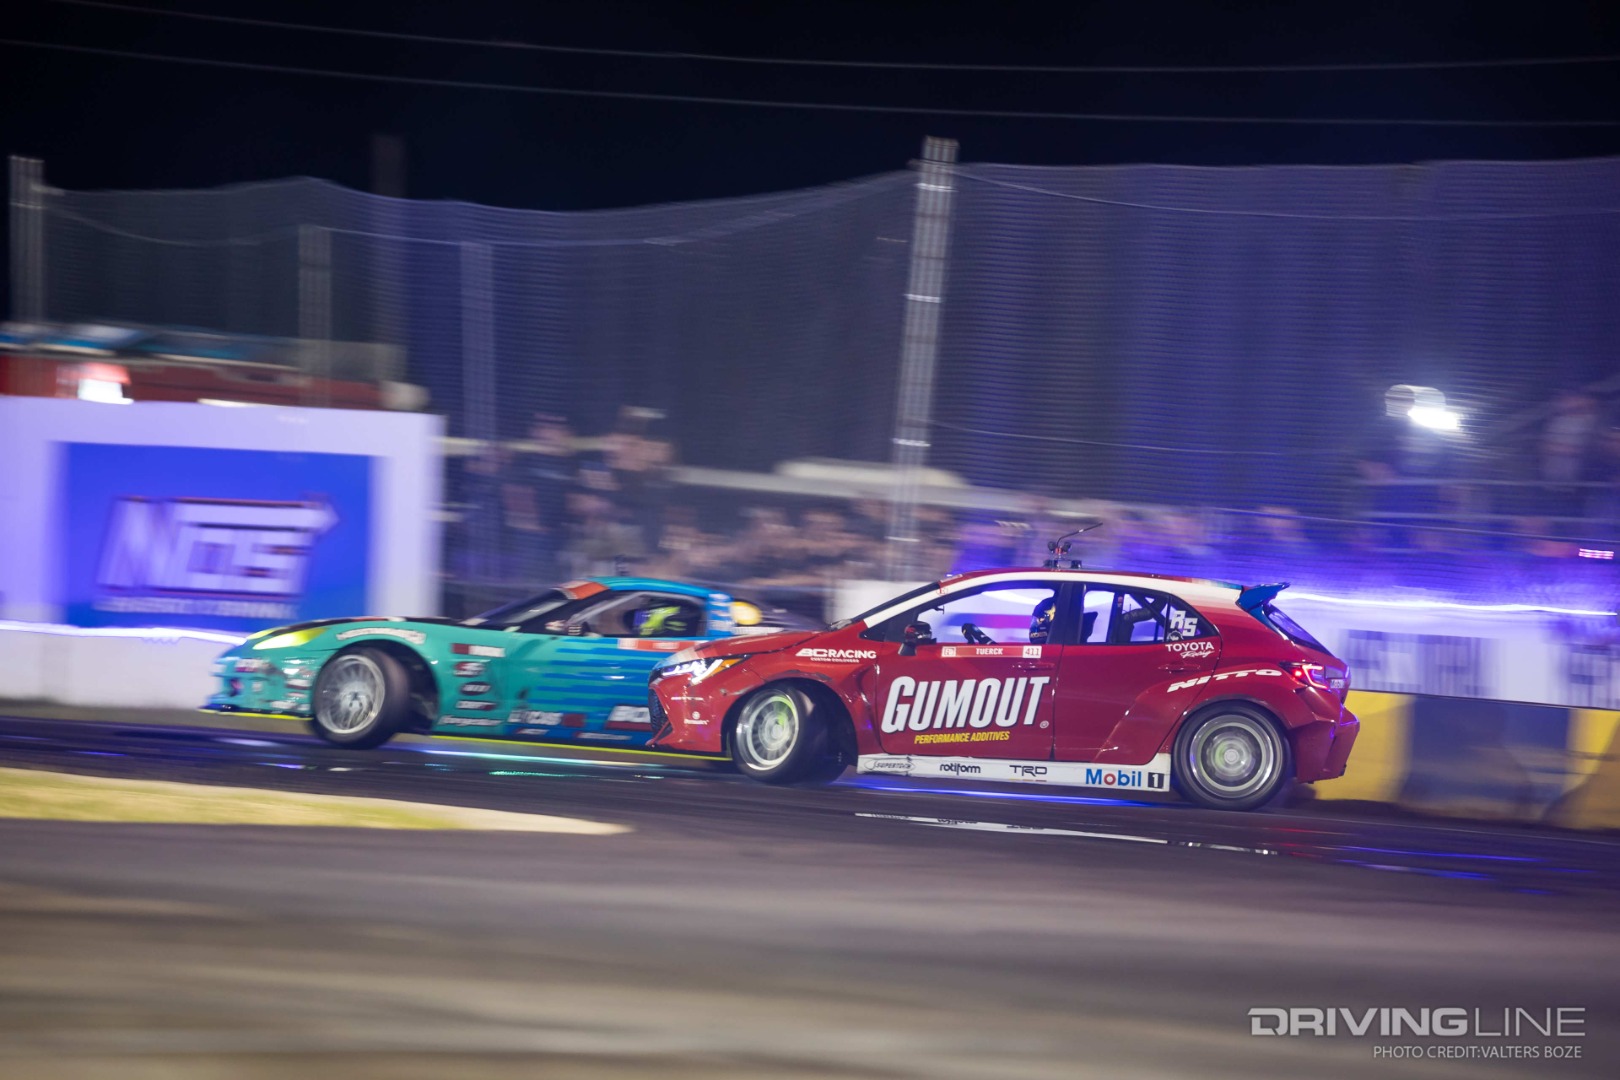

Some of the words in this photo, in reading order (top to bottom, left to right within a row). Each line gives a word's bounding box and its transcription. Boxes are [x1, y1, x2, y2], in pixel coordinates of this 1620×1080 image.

[101, 498, 337, 594] NOS
[1024, 648, 1040, 656] 411
[1165, 642, 1214, 652] TOYOTA
[1167, 669, 1282, 692] NITTO
[881, 676, 1050, 733] GUMOUT
[914, 732, 970, 744] PERFORMANCE
[970, 731, 1010, 741] ADDITIVES
[940, 763, 981, 775] rotiform
[1009, 764, 1047, 777] TRD
[1085, 768, 1141, 787] Mobil
[1151, 773, 1161, 788] 1
